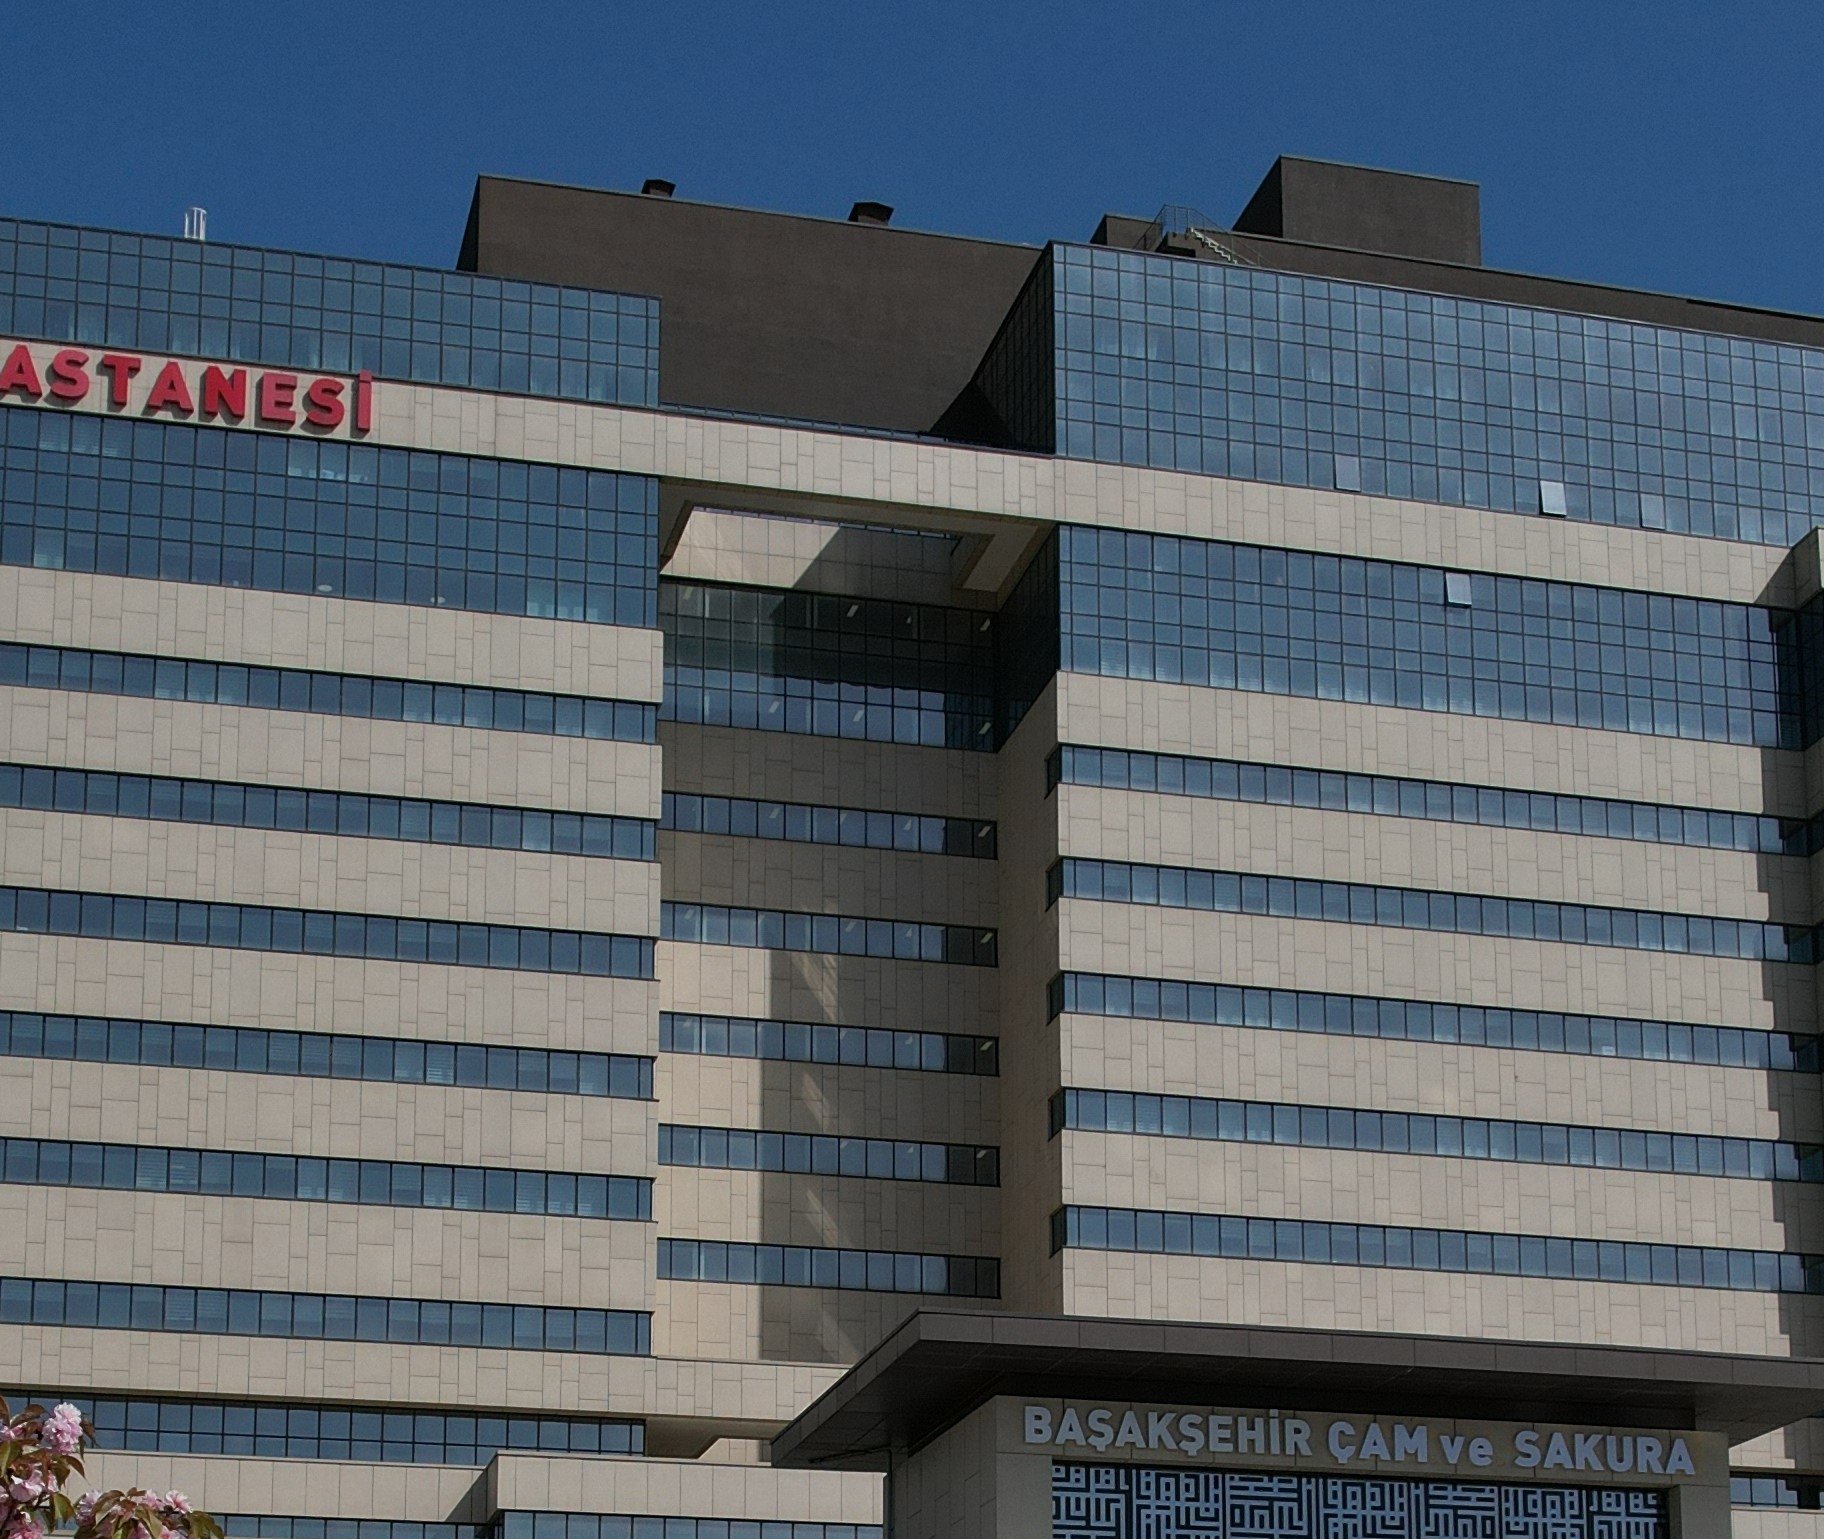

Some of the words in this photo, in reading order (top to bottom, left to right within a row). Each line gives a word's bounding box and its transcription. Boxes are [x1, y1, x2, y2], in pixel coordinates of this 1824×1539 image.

[1024, 1406, 1313, 1457] BAŞAKŞEHİR
[1327, 1420, 1428, 1464] ÇAM
[1439, 1434, 1494, 1467] ve
[1514, 1429, 1696, 1476] SAKURA
